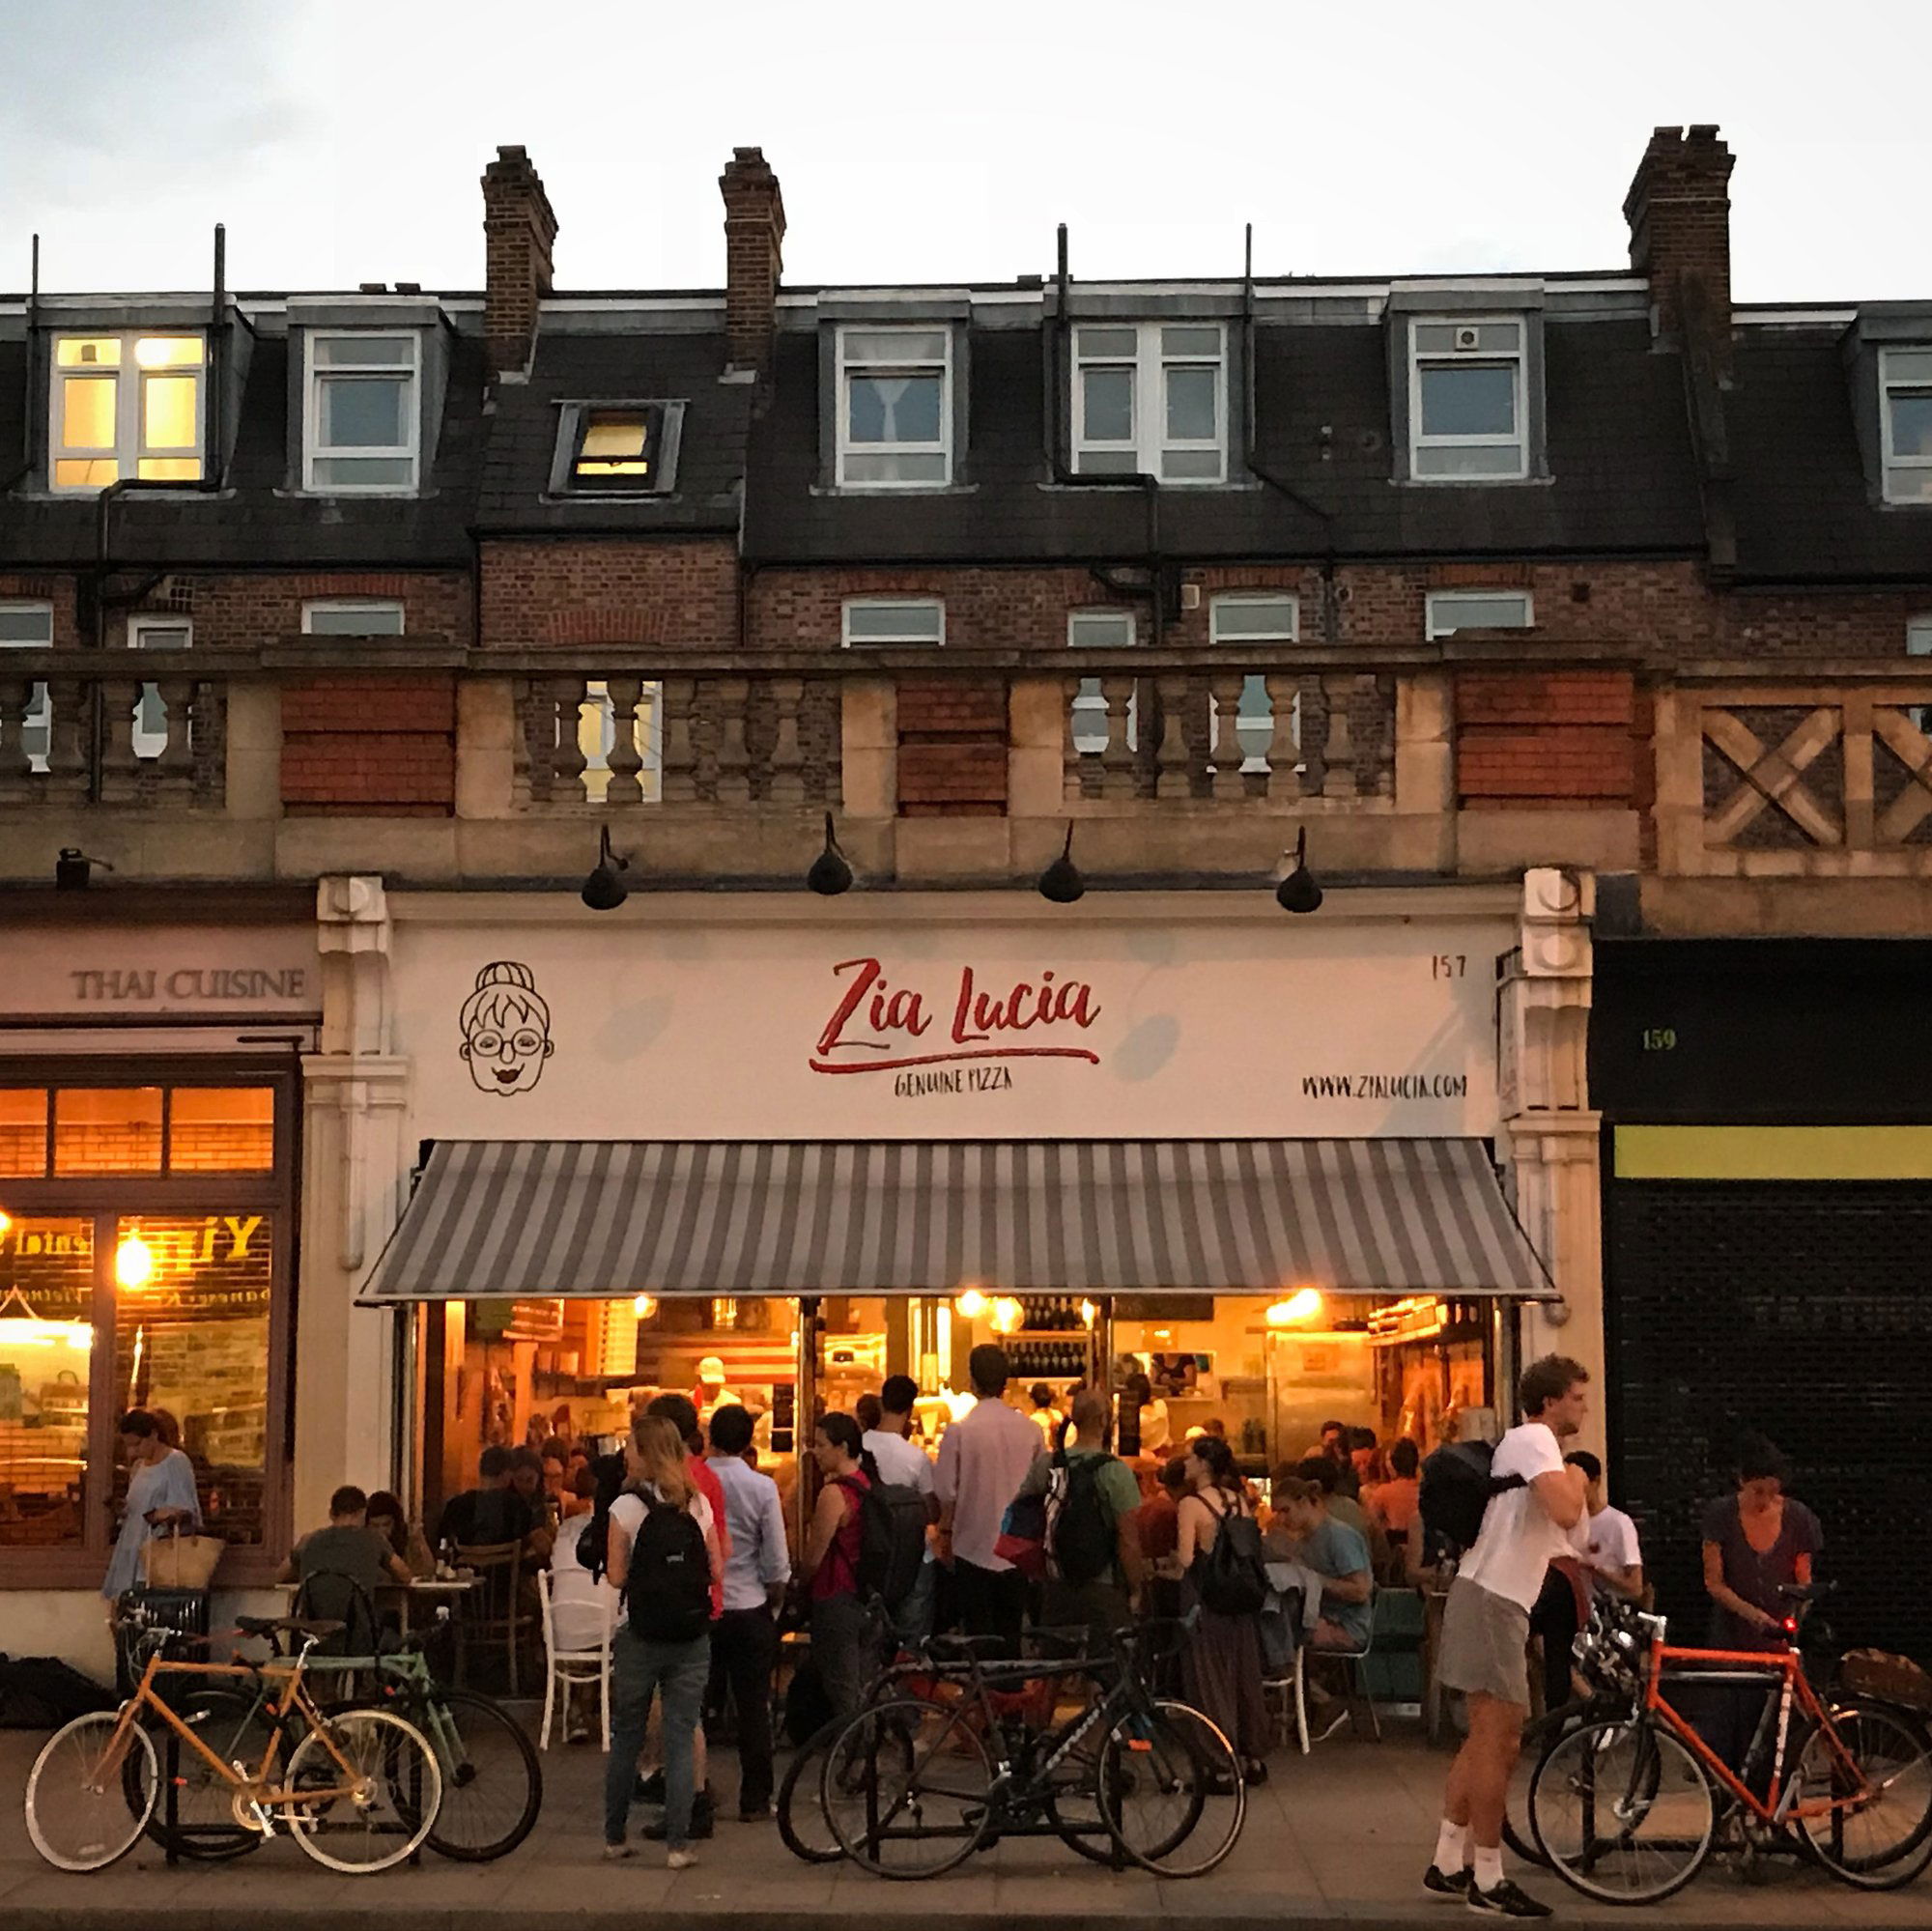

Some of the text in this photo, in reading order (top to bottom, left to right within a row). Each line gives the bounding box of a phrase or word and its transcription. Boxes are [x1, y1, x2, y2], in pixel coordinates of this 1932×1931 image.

[1432, 955, 1466, 980] 157
[70, 968, 305, 1000] THAI CUISINE
[817, 957, 1101, 1056] Zia Lucia
[1643, 1028, 1677, 1051] 159
[895, 1066, 1013, 1097] GENUINE PIZZA
[1301, 1075, 1467, 1098] WWW.ZIALUCIA.COM
